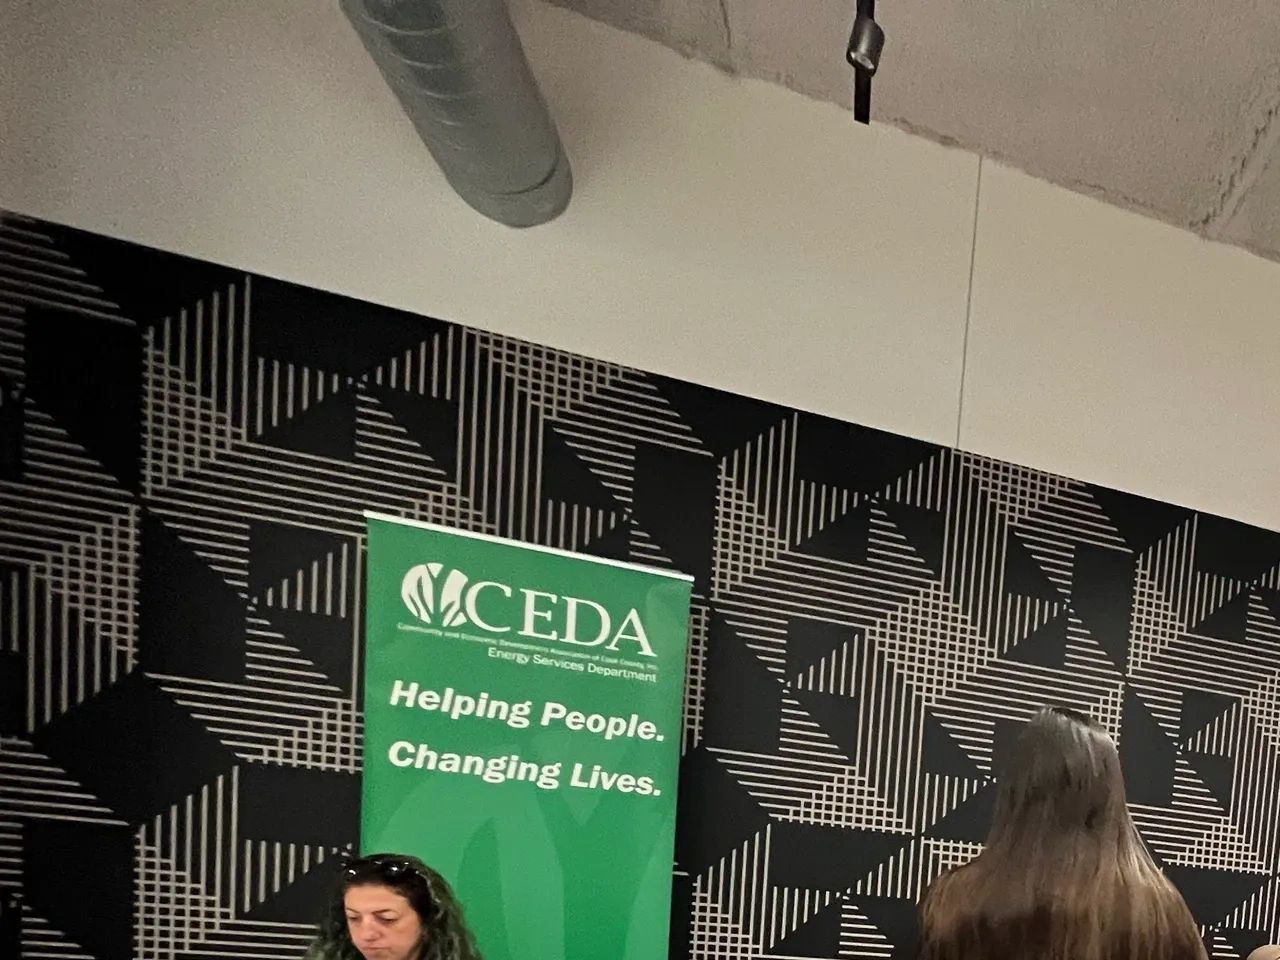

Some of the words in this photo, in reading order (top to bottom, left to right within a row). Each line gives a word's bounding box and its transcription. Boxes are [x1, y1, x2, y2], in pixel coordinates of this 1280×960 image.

[466, 581, 658, 657] CEDA
[488, 646, 530, 665] Energy
[533, 654, 585, 672] Services
[587, 662, 658, 683] Department
[389, 679, 533, 729] Helping
[540, 701, 665, 741] People.
[388, 740, 562, 790] Changing
[570, 763, 662, 797] Lives.
